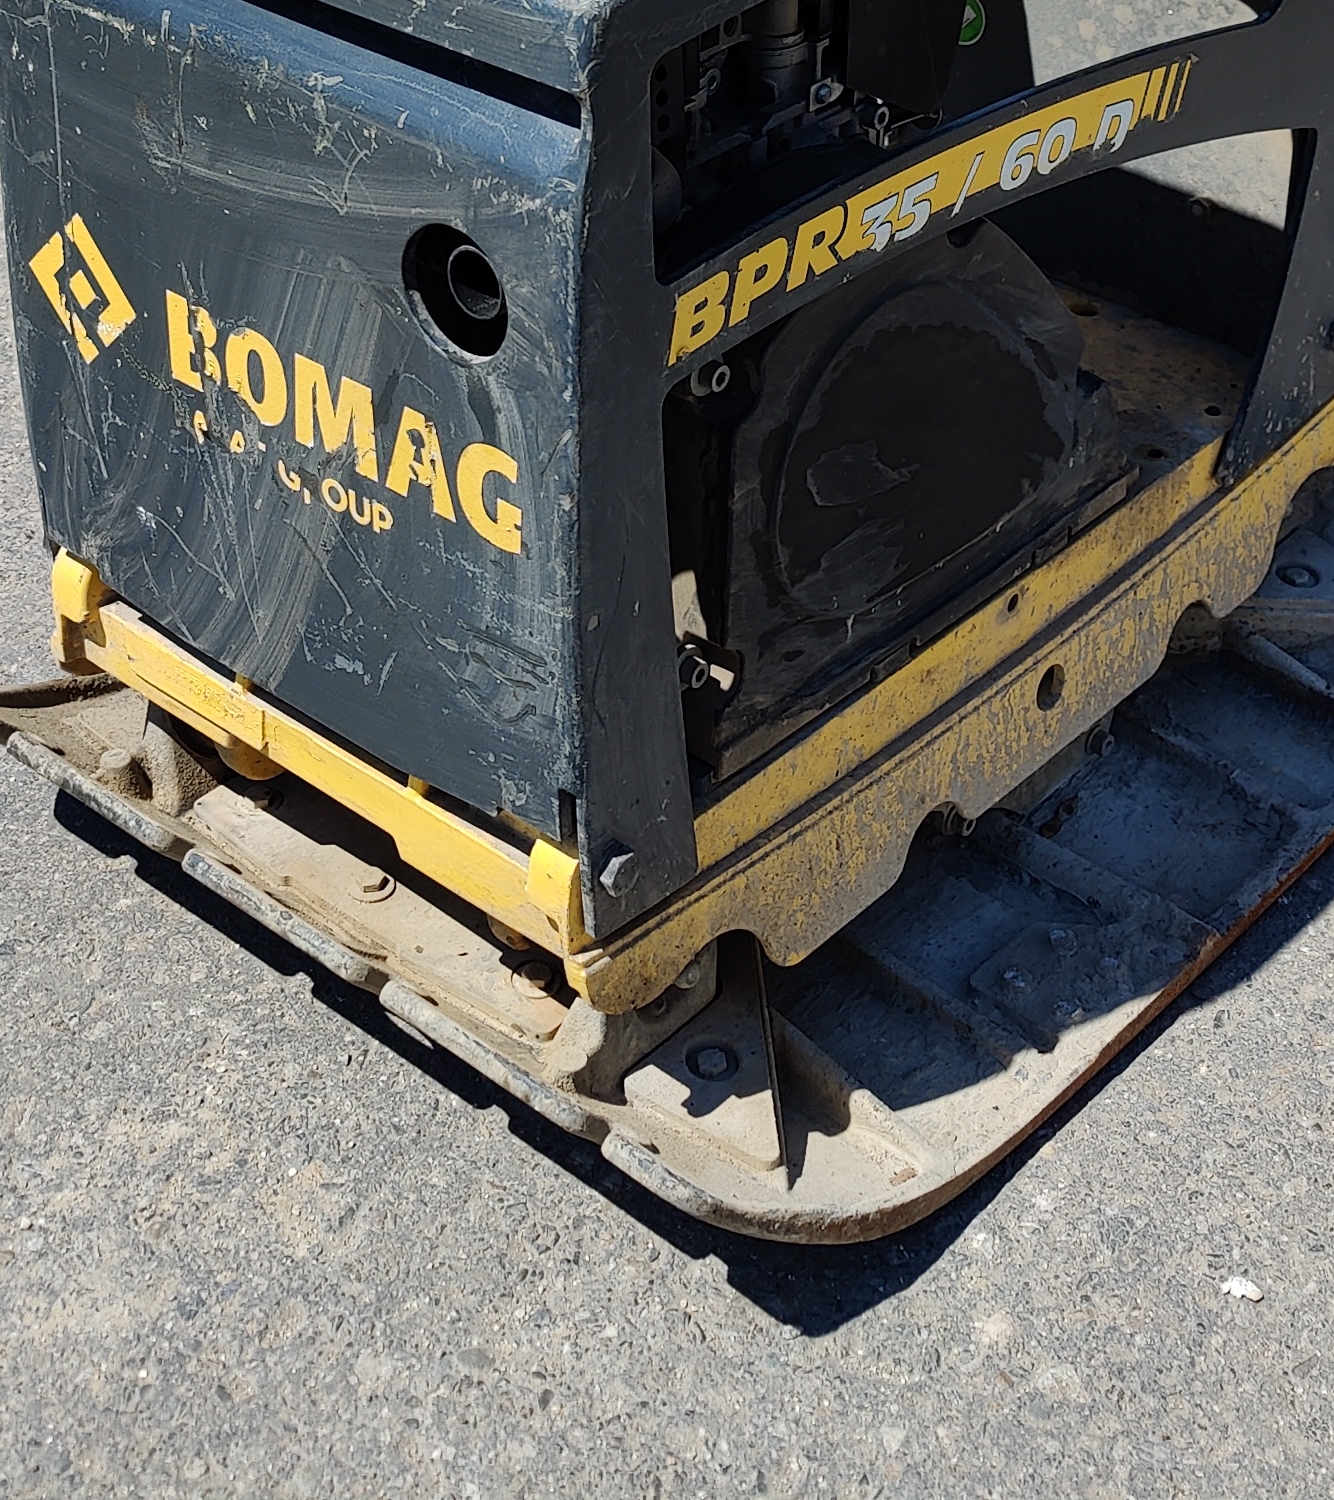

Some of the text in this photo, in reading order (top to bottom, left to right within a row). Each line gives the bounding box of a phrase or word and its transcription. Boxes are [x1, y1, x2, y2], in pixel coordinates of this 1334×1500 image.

[668, 204, 847, 367] BPR
[998, 117, 1078, 191] 60
[165, 288, 523, 555] BOMAG
[277, 458, 394, 534] GOUP
